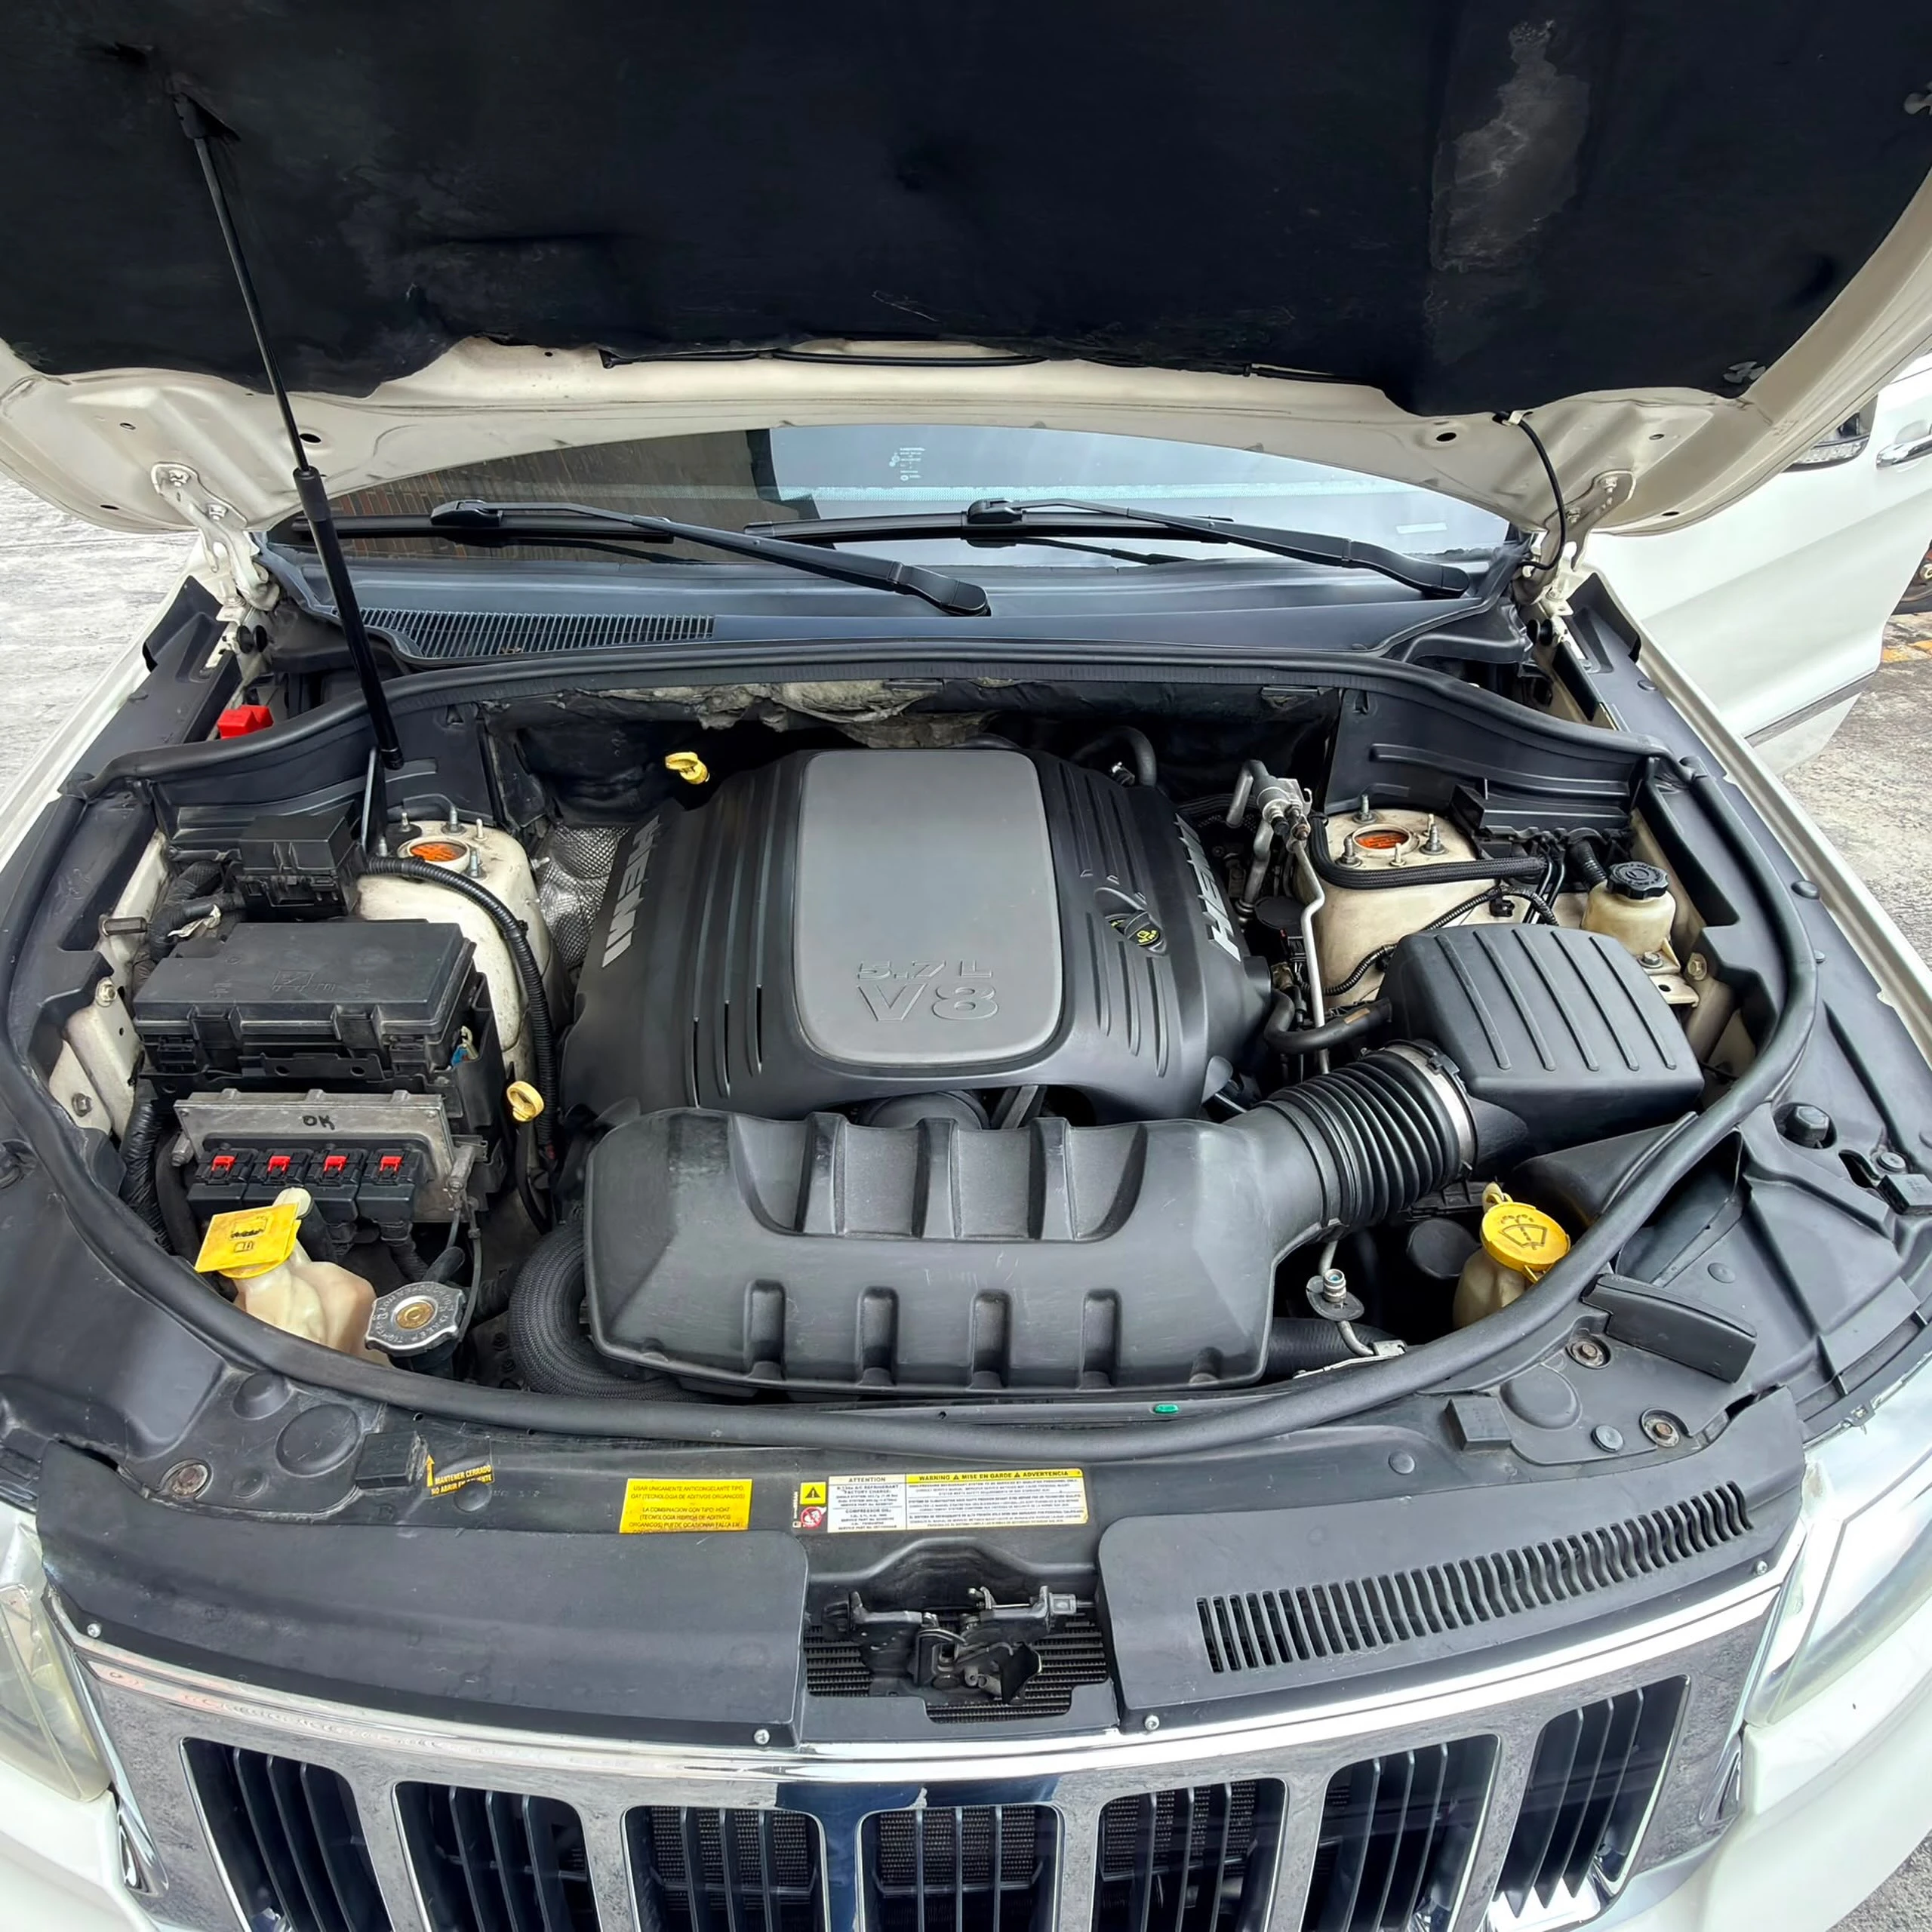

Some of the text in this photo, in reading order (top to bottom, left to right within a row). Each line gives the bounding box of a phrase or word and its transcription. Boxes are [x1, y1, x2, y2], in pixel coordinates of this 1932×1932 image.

[602, 814, 661, 968] HEMI
[855, 981, 999, 1021] V8
[302, 1115, 335, 1131] OK
